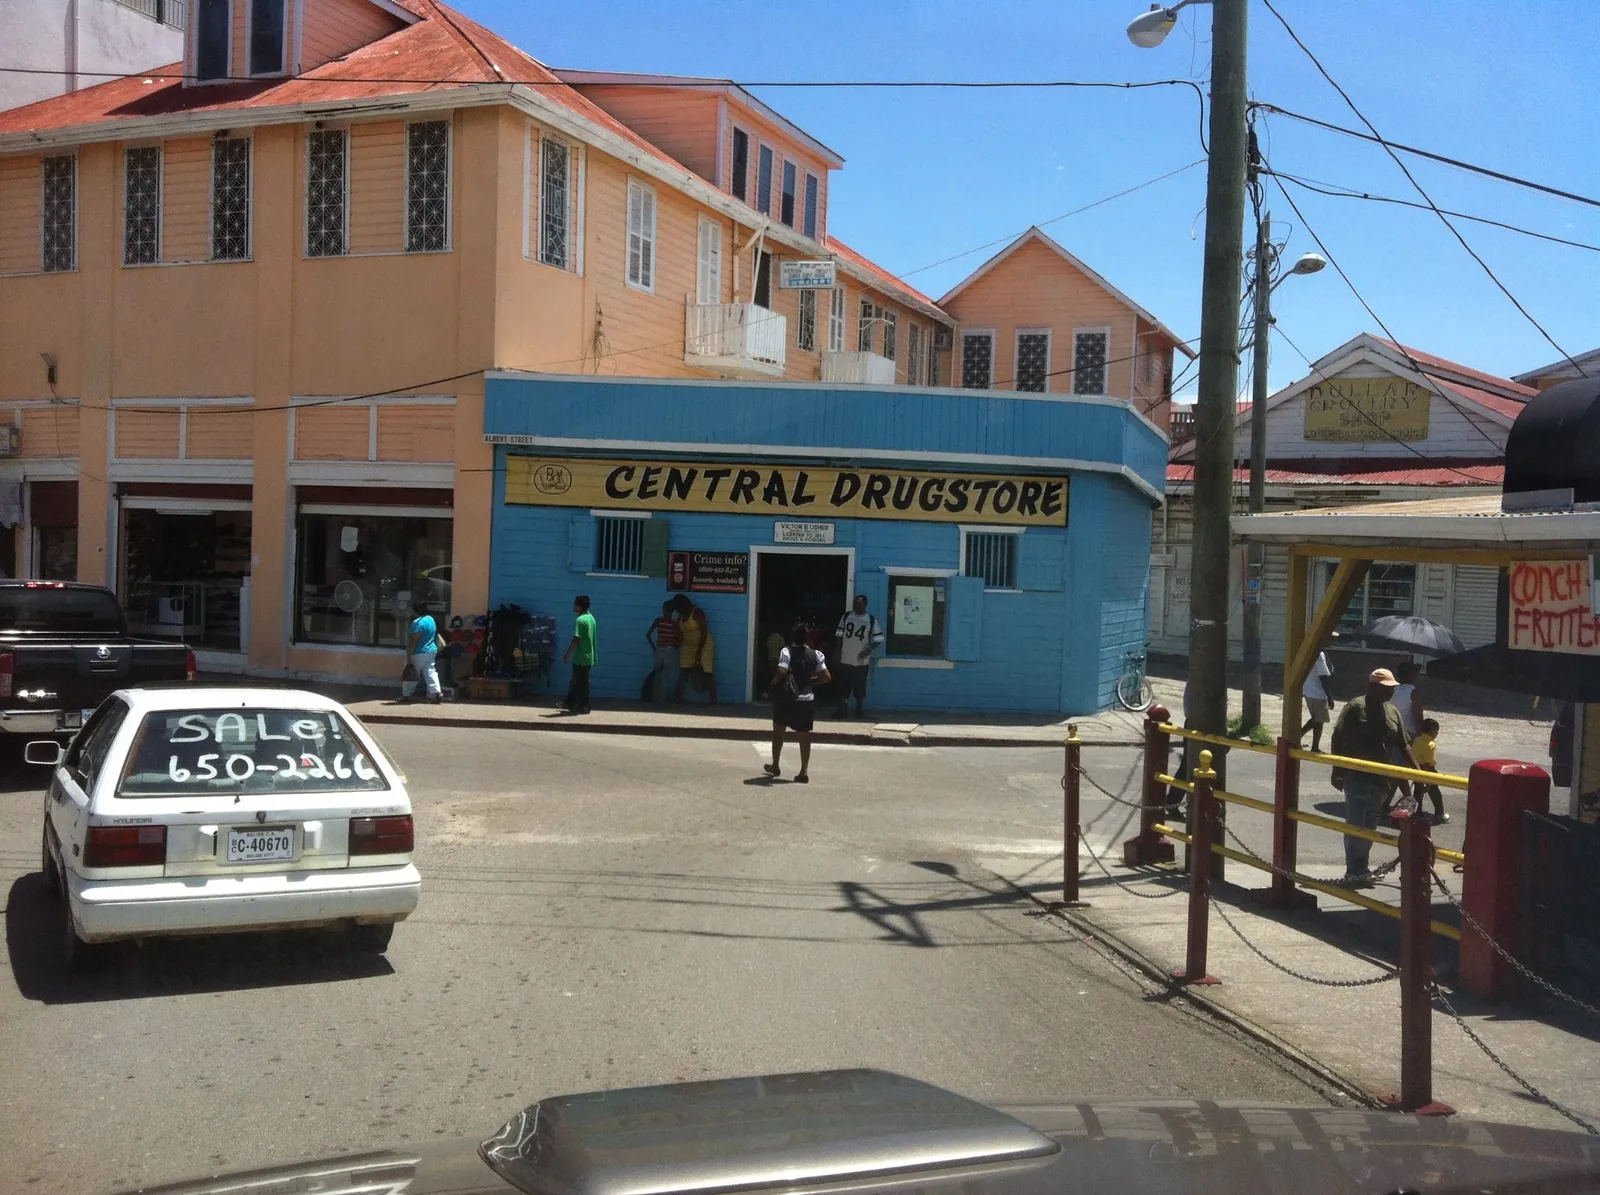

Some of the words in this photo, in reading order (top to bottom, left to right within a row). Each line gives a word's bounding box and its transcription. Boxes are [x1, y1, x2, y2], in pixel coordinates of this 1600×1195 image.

[484, 434, 507, 443] ALBERT
[510, 436, 533, 444] STREET
[605, 466, 815, 507] CENTRAL
[830, 472, 1063, 517] DRUGSTORE
[694, 554, 723, 565] Crime
[724, 555, 747, 566] info?
[1511, 562, 1582, 606] CONCH
[846, 622, 866, 641] 94
[169, 753, 375, 782] 650-2266
[113, 817, 152, 825] HYUNDAI
[238, 837, 289, 853] C-40670
